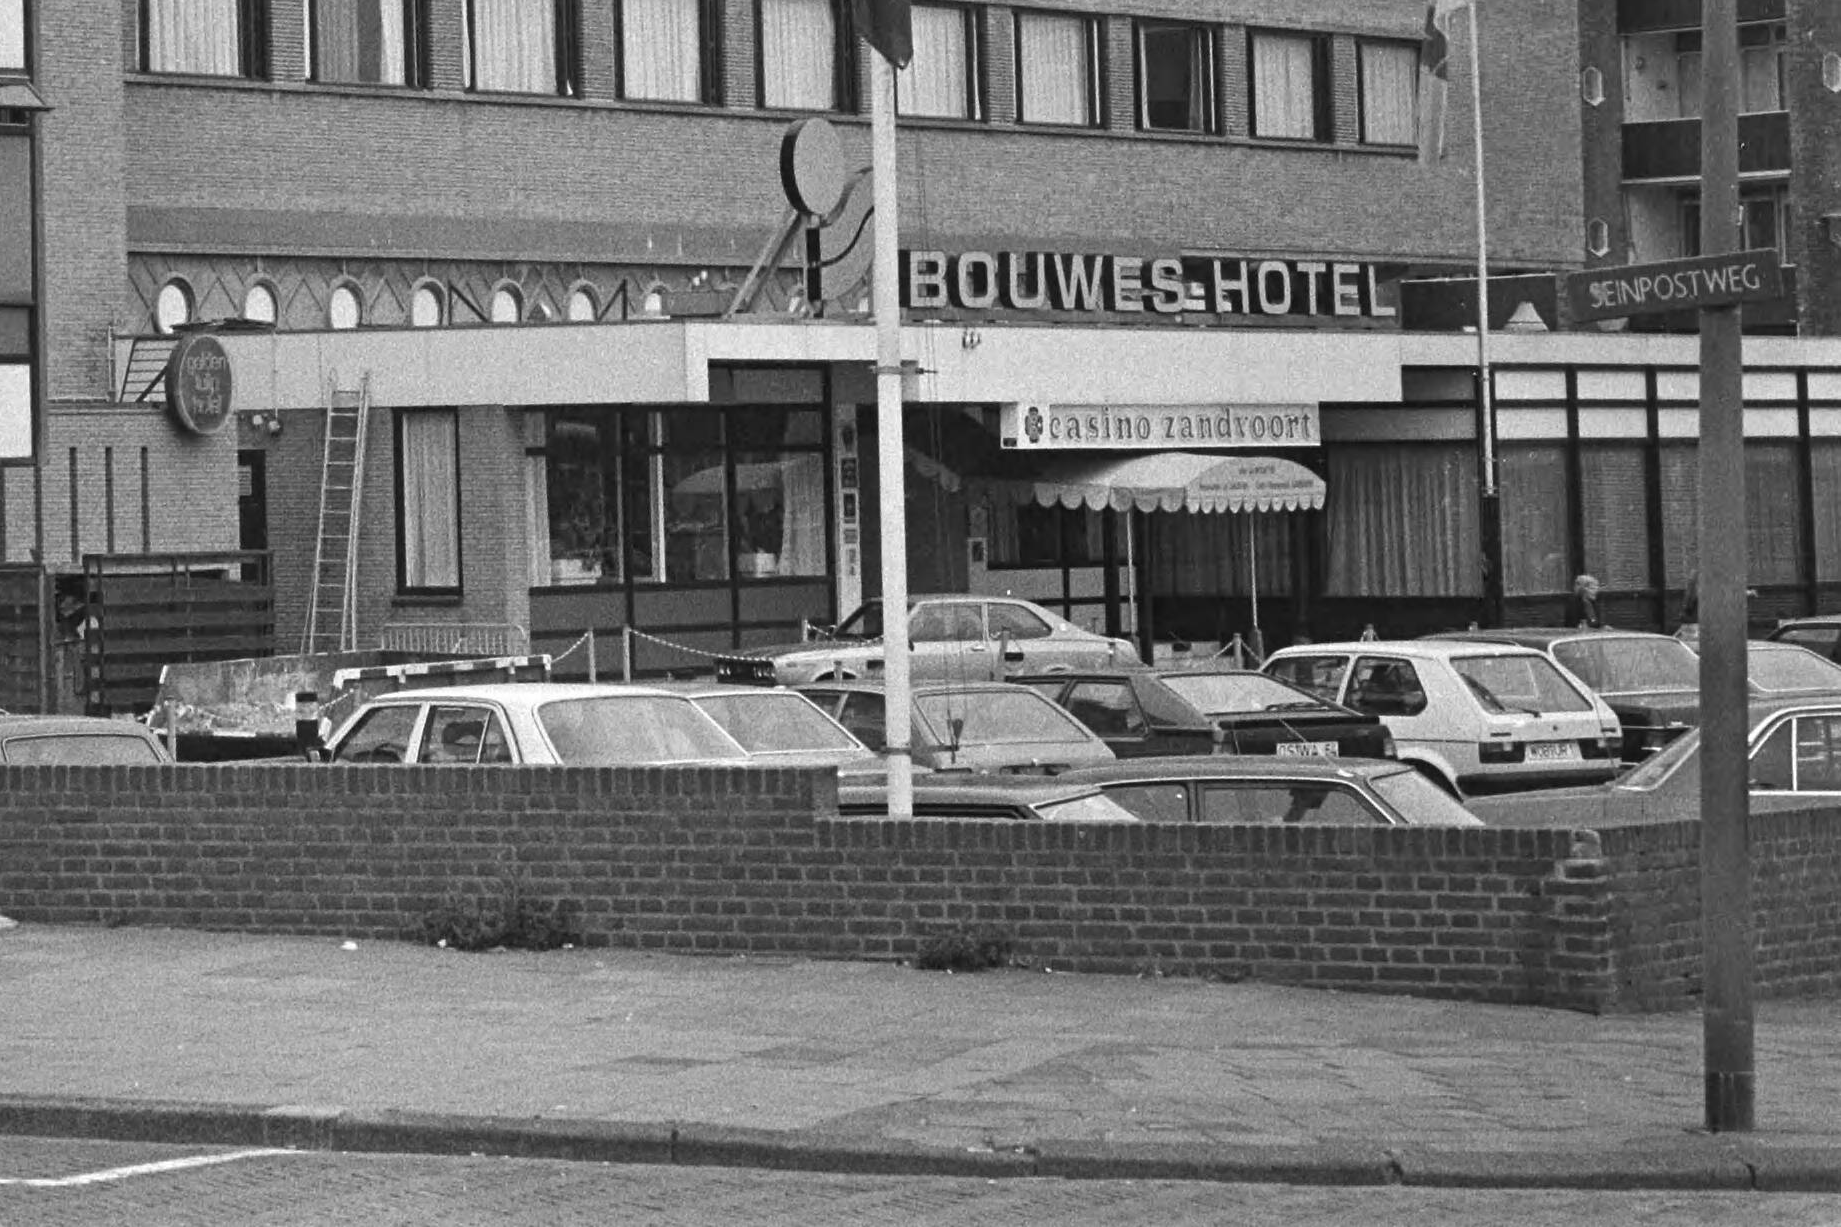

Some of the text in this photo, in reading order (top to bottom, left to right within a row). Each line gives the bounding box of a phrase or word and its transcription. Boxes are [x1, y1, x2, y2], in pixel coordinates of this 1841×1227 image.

[908, 250, 1184, 313] BOUWES
[1589, 264, 1760, 308] SEINPOSTWEG
[1049, 407, 1312, 441] casino zandvoort
